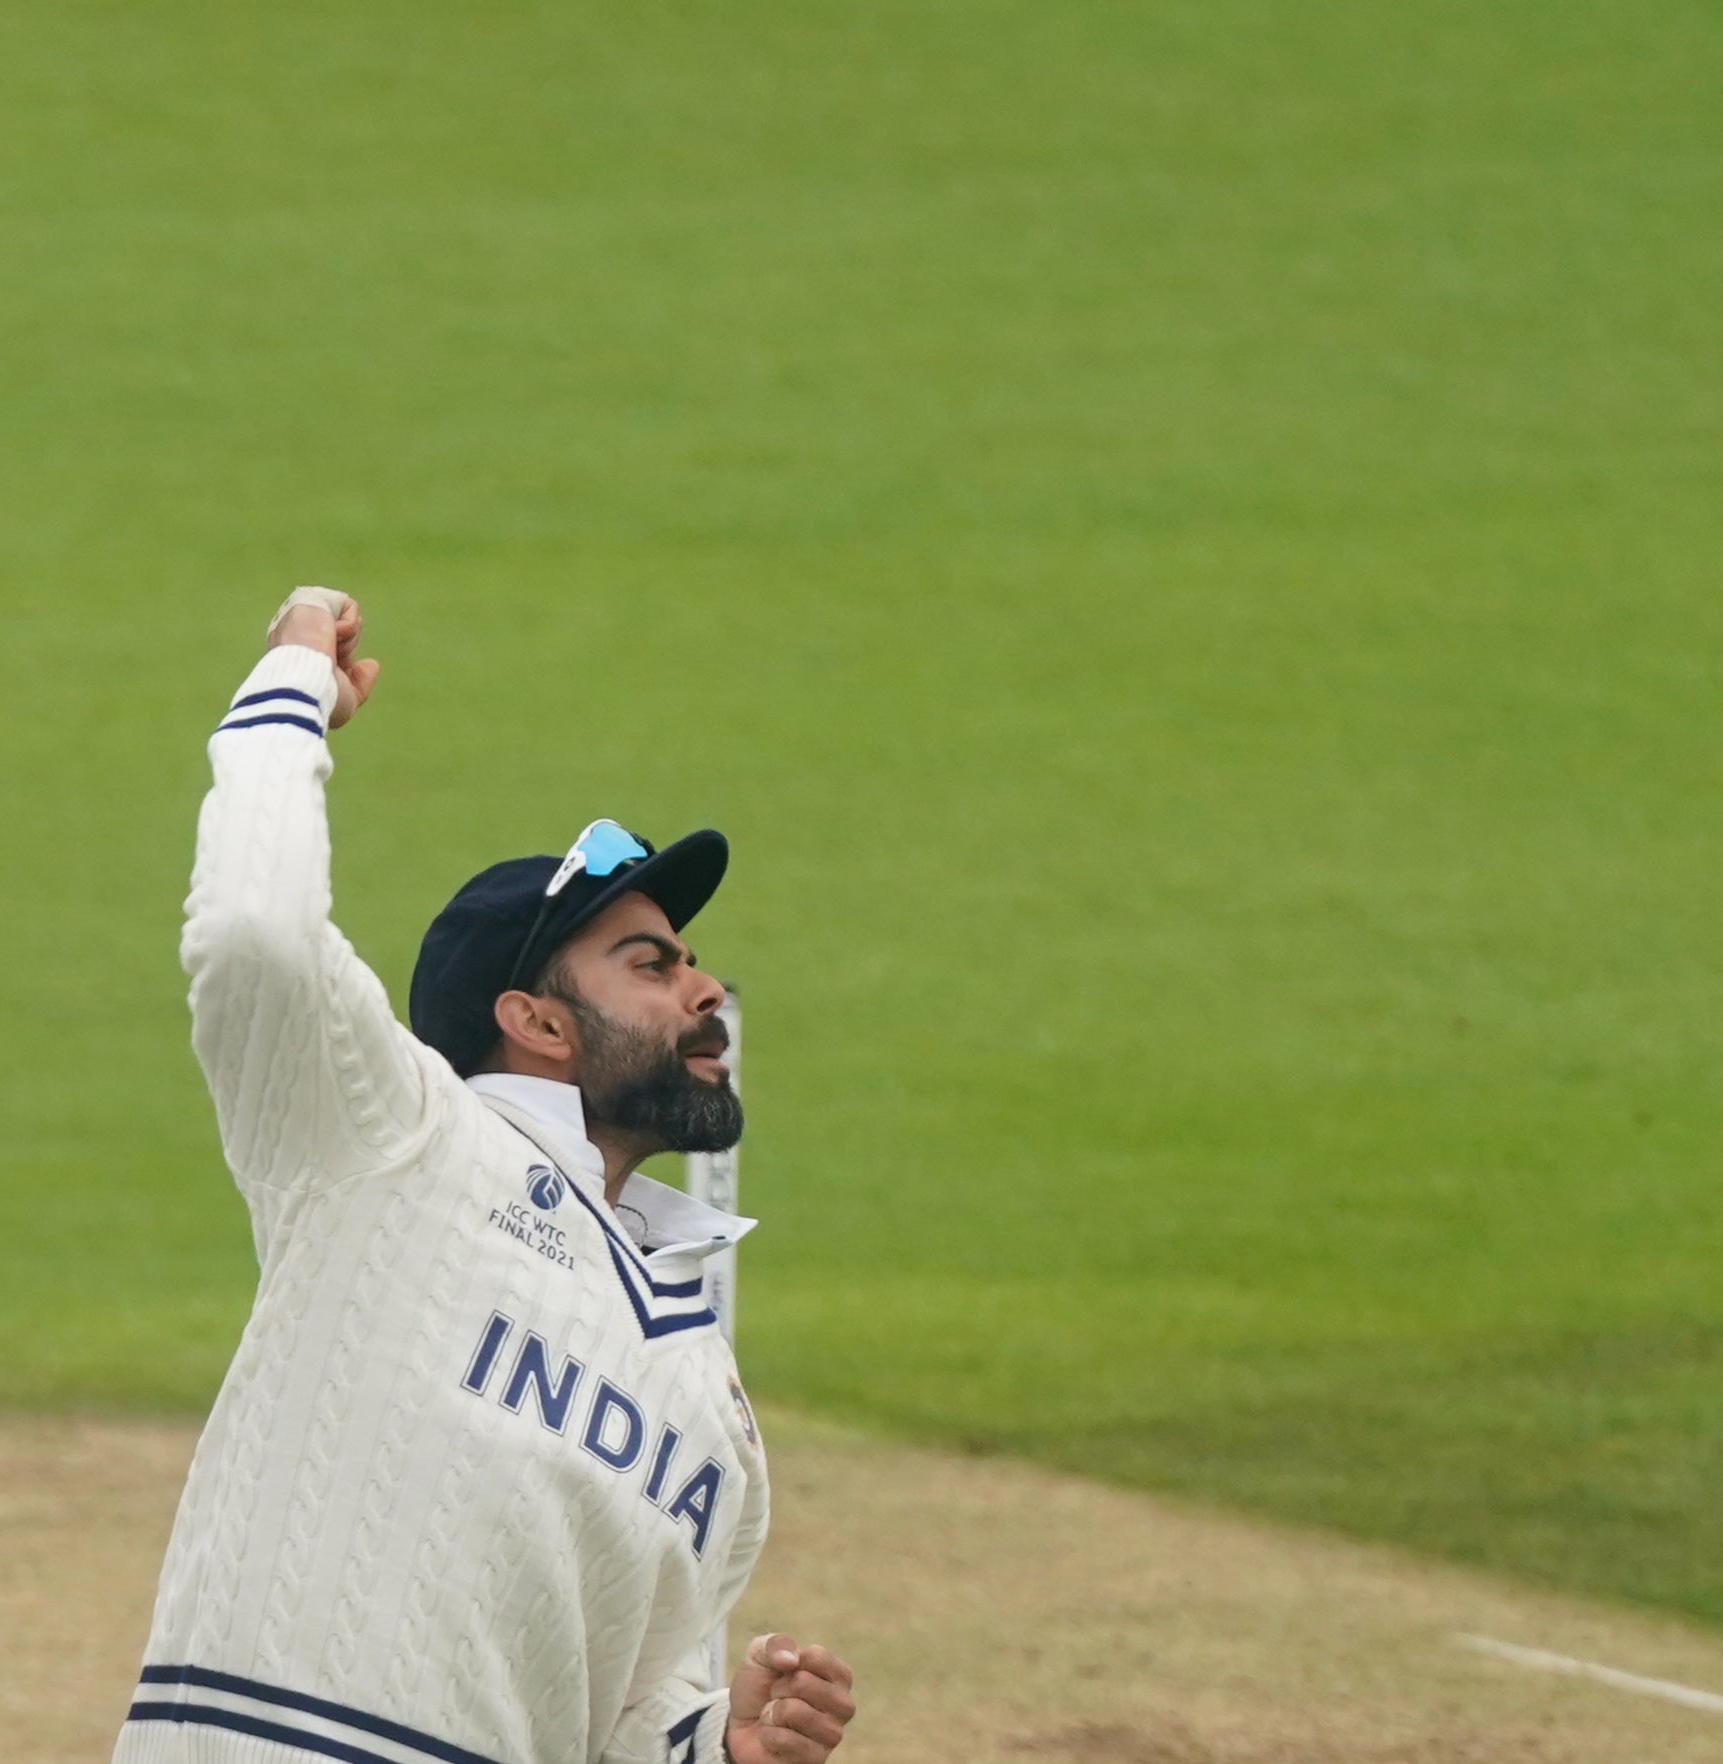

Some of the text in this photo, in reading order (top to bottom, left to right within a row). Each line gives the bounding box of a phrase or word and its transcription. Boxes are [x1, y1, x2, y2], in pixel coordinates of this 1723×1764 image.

[488, 1208, 575, 1270] FINAL 2021
[506, 1200, 567, 1247] ICC WTC
[460, 1309, 726, 1562] INDIA
